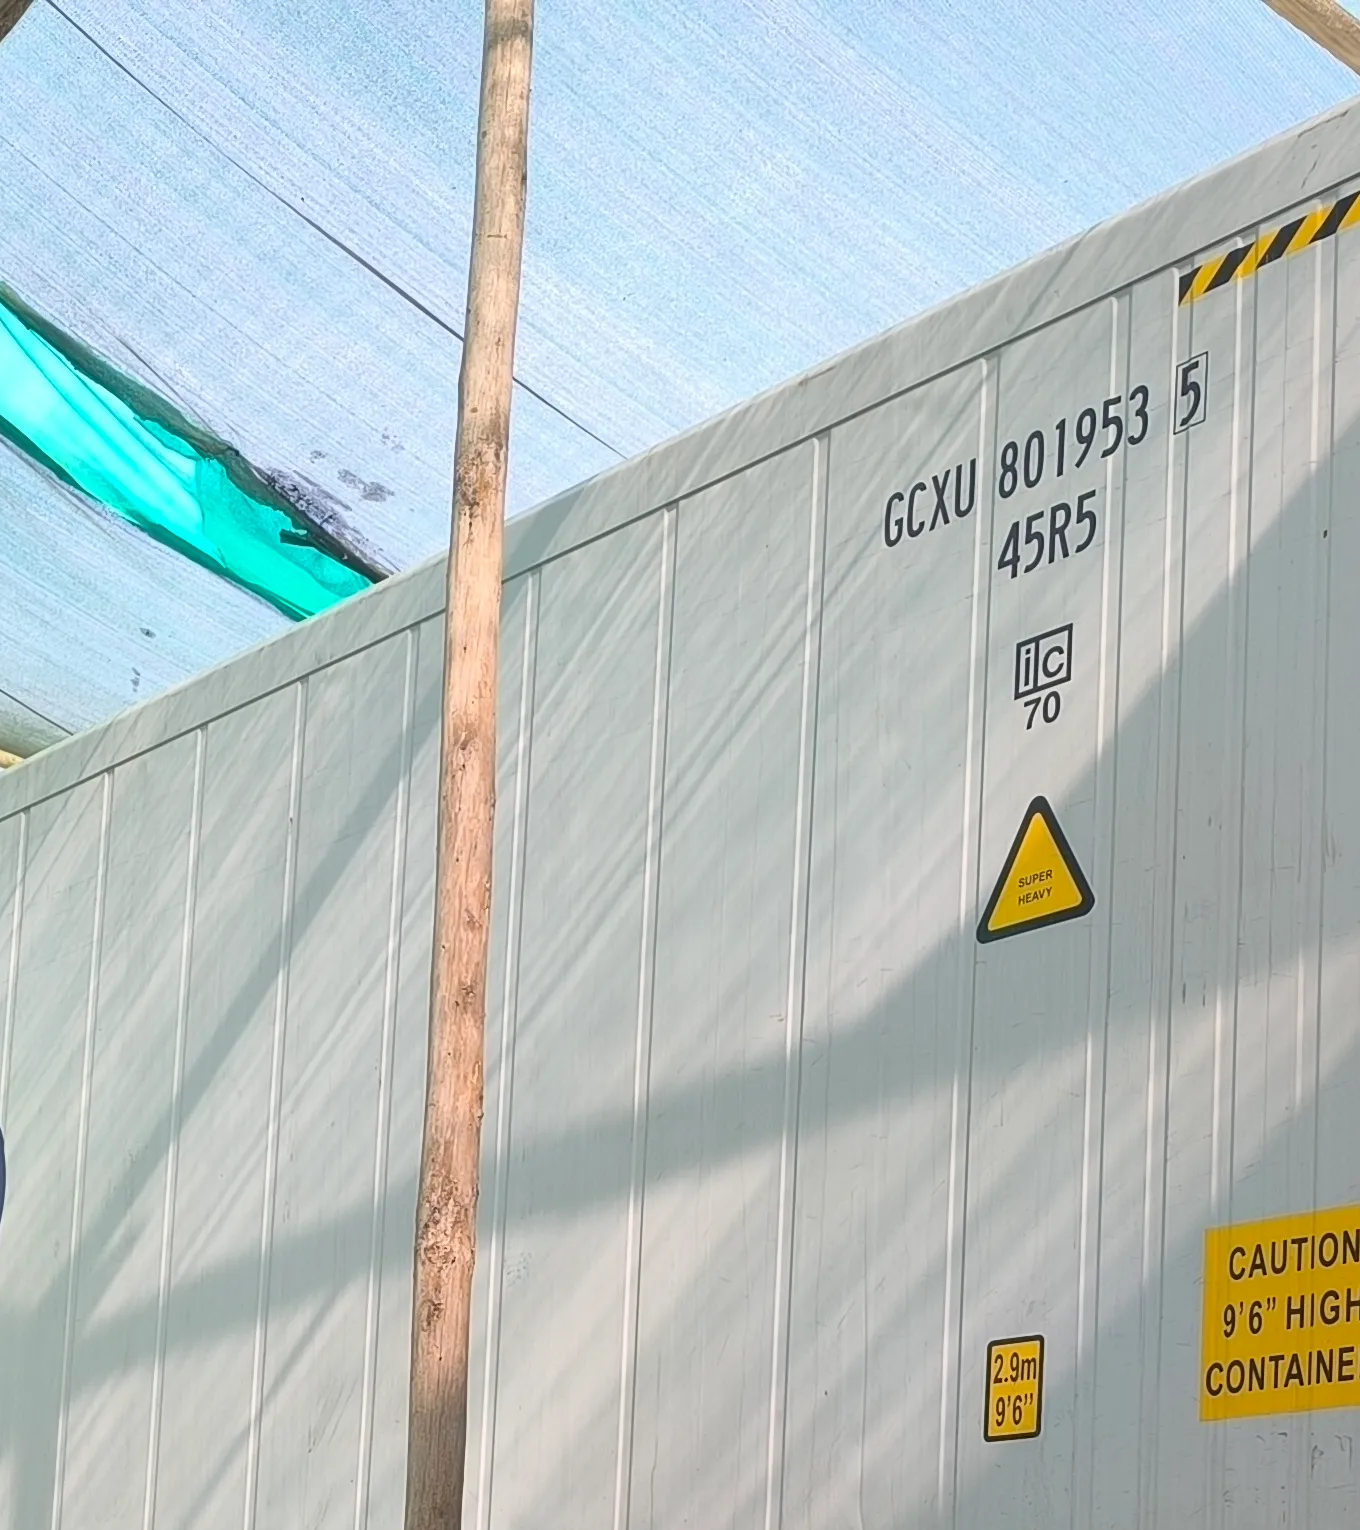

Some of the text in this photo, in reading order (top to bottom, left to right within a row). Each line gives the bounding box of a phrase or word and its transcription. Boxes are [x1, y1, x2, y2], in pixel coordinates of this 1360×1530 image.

[883, 359, 1202, 547] GCXU 801953 5
[997, 489, 1098, 580] 45R5
[1024, 691, 1061, 730] 70
[1018, 869, 1053, 888] SUPER
[1018, 887, 1053, 906] HEAVY
[1228, 1228, 1360, 1281] CAUTION
[993, 1352, 1037, 1385] 2.9m
